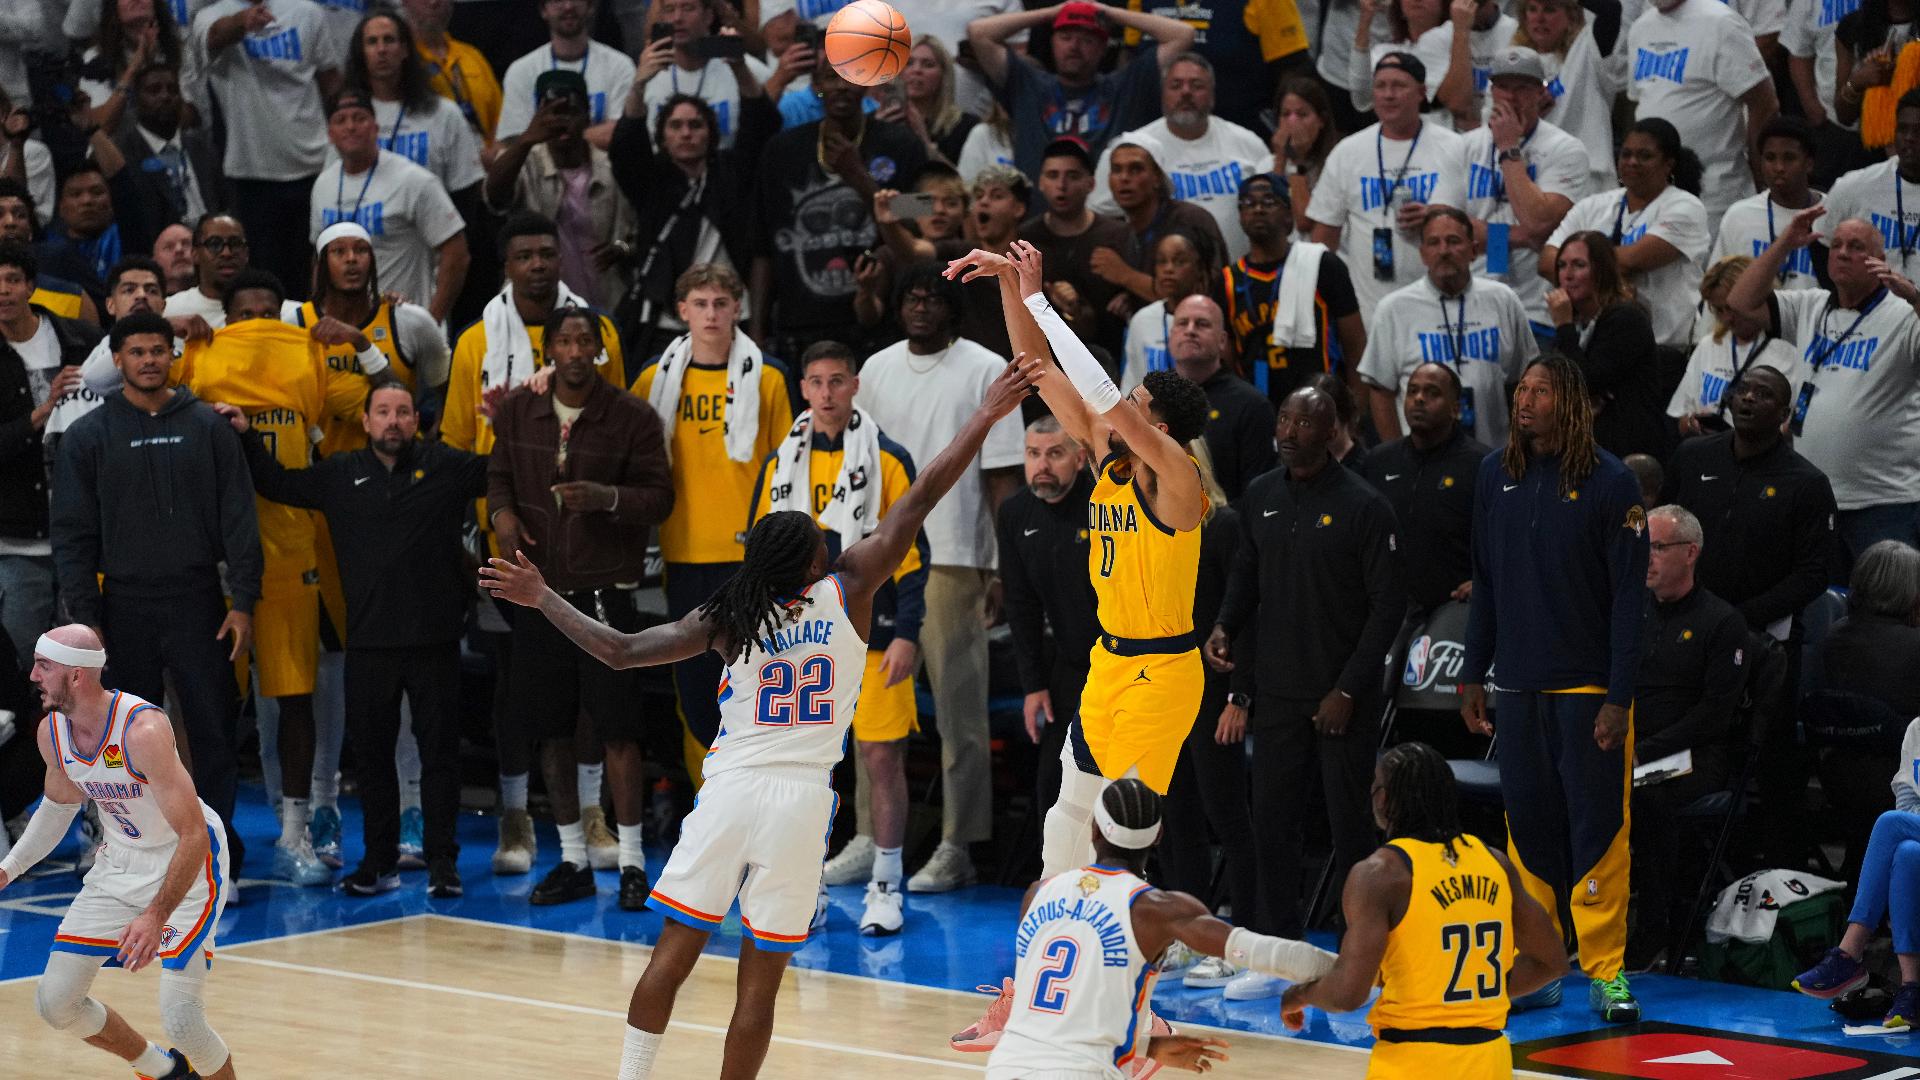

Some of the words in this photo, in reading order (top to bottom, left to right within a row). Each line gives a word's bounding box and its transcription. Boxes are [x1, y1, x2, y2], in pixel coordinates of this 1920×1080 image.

[676, 394, 724, 422] ACE
[1100, 534, 1115, 578] 0
[761, 619, 834, 657] WALLACE
[755, 653, 835, 727] 22
[1430, 874, 1499, 911] NESMITH
[1016, 897, 1129, 968] GILGEOUS-ALEXANDER
[1028, 935, 1081, 1015] 2
[1441, 920, 1503, 1003] 23
